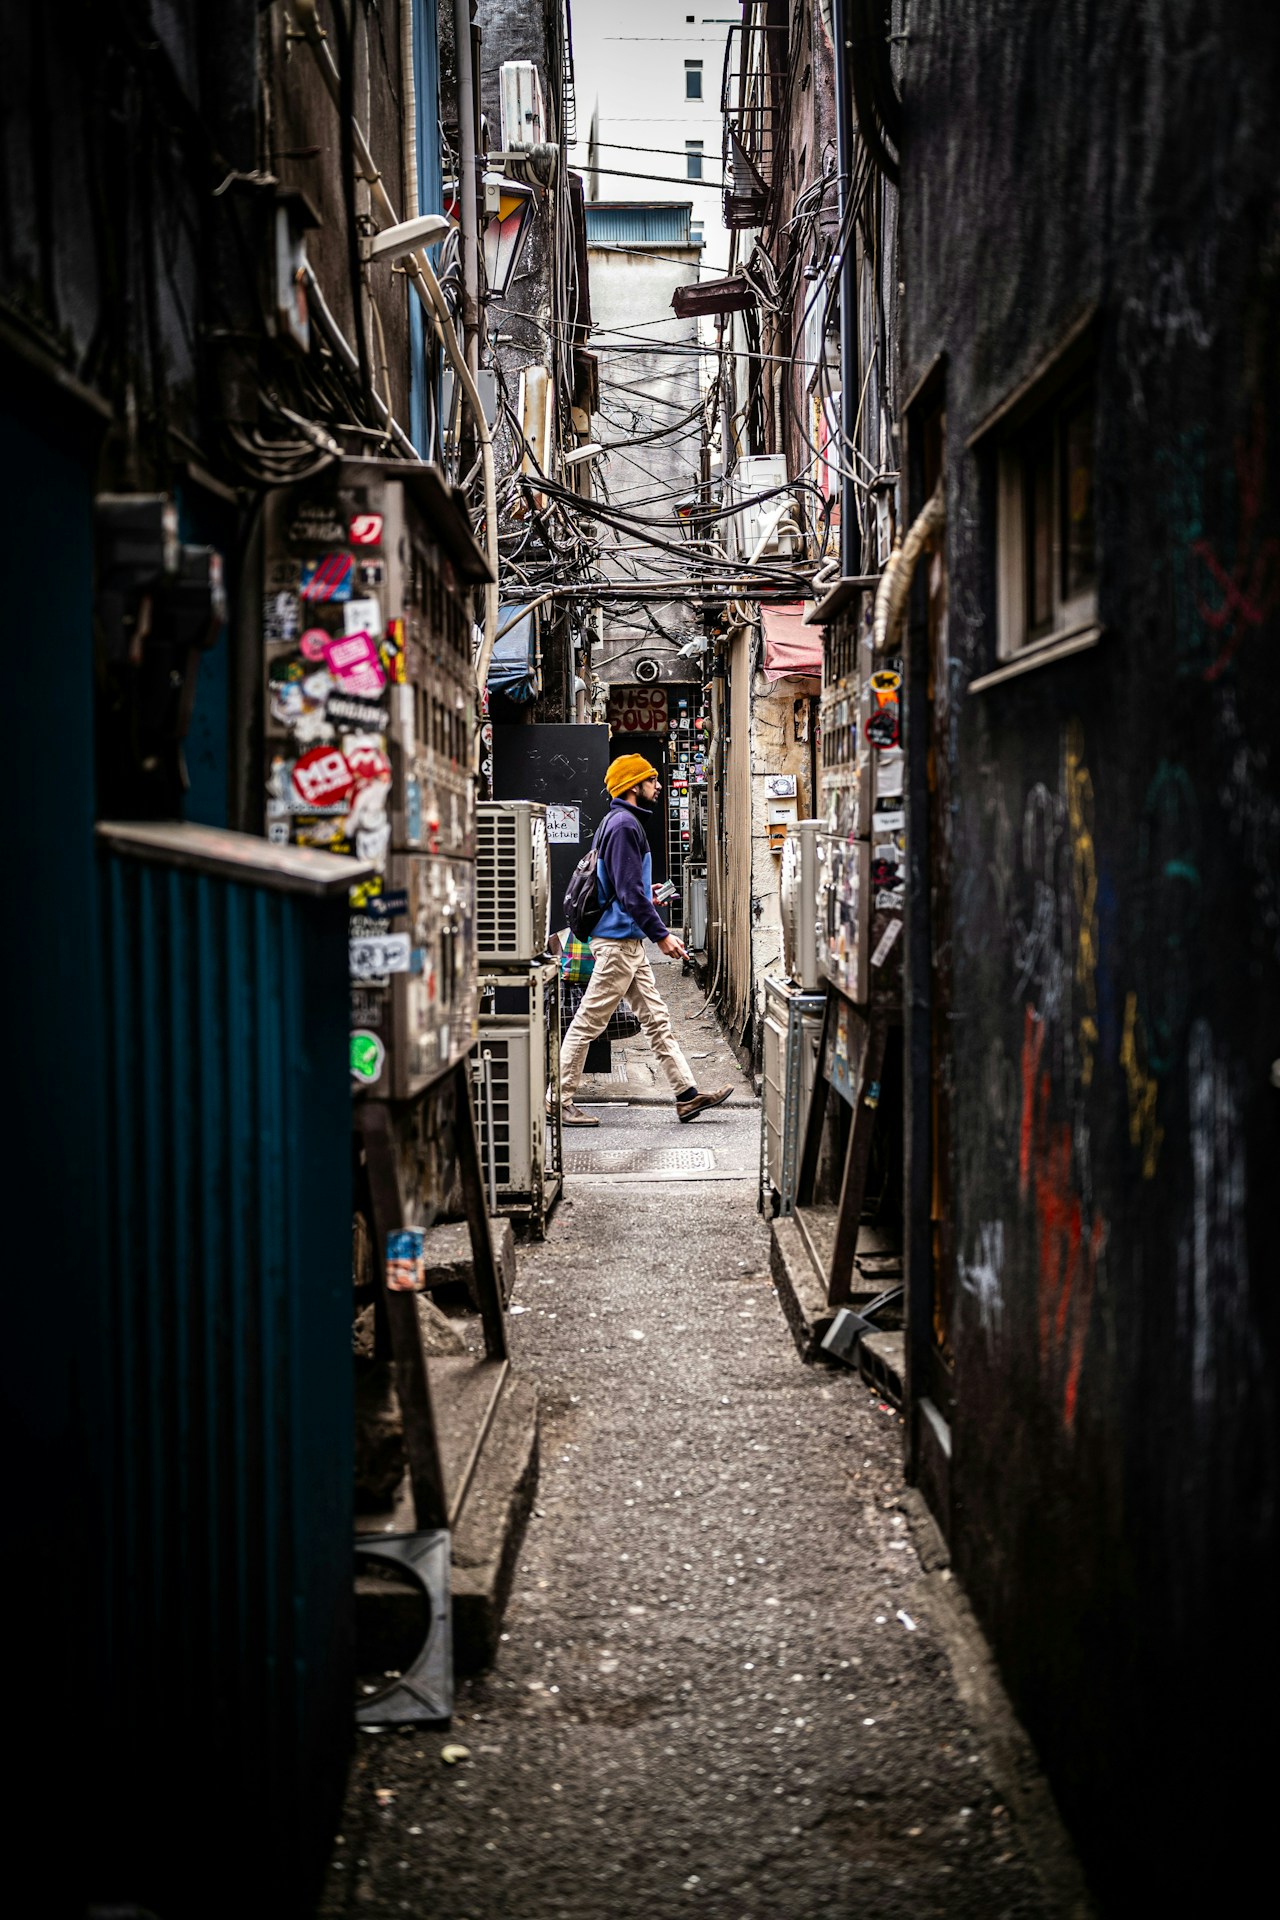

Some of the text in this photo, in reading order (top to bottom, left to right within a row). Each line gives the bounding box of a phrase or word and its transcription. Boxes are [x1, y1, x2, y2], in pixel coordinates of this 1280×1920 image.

[609, 689, 666, 709] MISO
[608, 709, 667, 731] SOUP
[546, 820, 568, 830] ake
